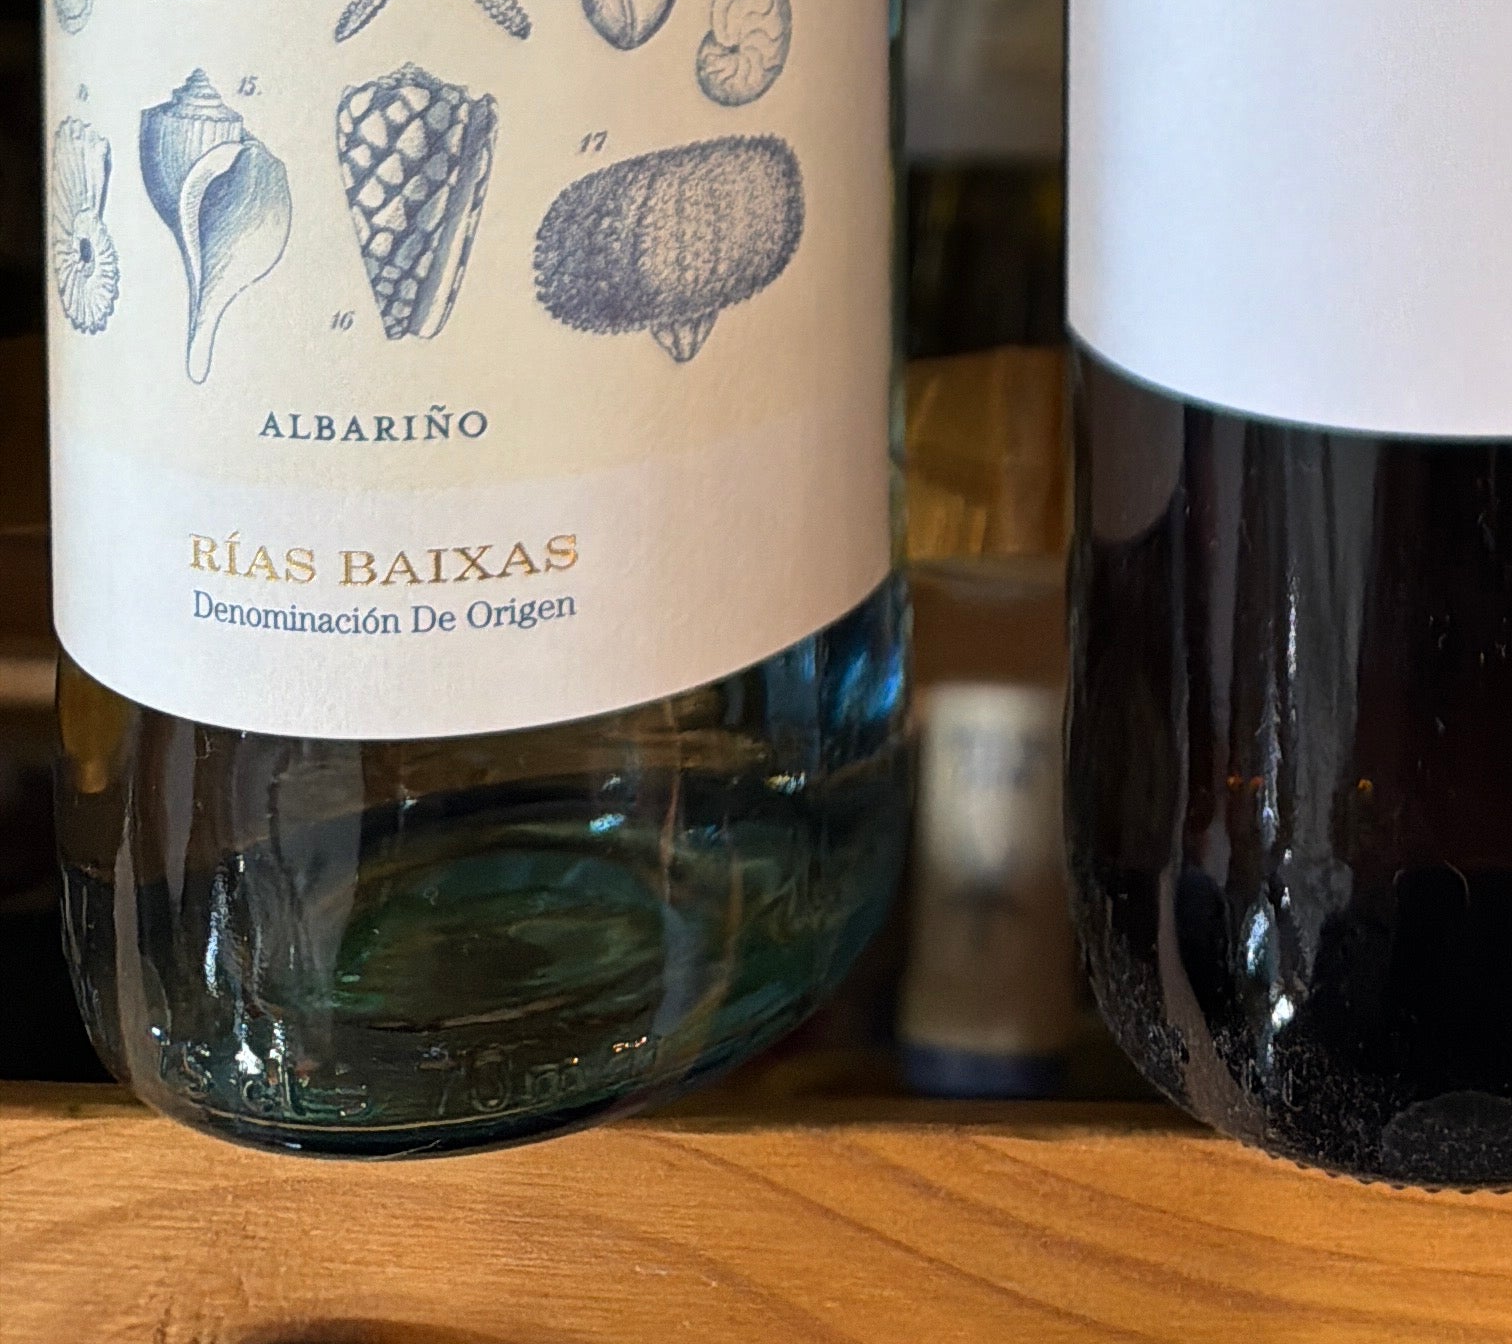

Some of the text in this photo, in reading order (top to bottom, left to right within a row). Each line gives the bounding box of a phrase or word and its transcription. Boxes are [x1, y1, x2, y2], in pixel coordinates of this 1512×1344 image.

[260, 404, 489, 443] ALBARIÑO
[189, 531, 579, 586] RÍAS BAIXAS
[193, 590, 577, 635] Denominación De Origen
